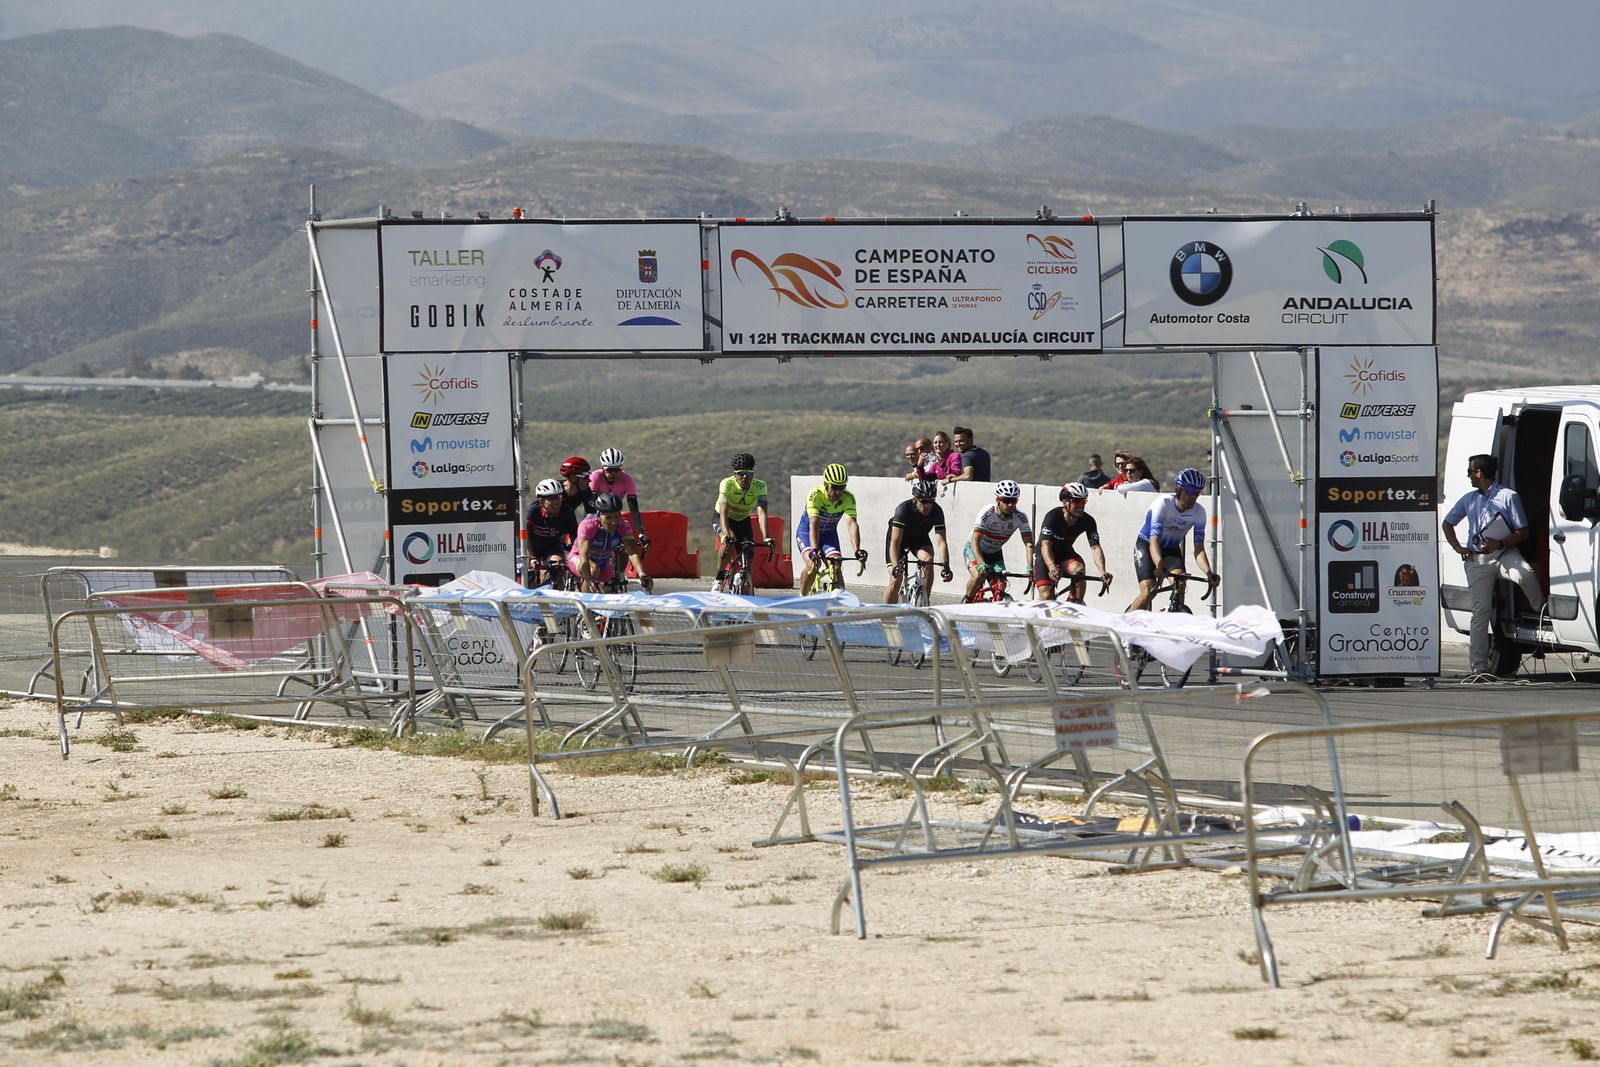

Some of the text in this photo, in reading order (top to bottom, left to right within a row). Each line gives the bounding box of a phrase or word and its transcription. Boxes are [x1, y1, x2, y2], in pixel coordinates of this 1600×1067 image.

[408, 249, 485, 266] TALLER
[855, 248, 996, 264] CAMPEONATO
[1175, 242, 1227, 262] BMW
[855, 265, 967, 283] DE ESPAÑA
[1027, 265, 1078, 274] CICLISMO
[409, 273, 486, 288] emarketing
[616, 287, 682, 299] DIPUTACIÓN
[509, 299, 582, 311] ALMERÍA
[617, 299, 681, 310] DE ALMERÍA
[855, 296, 949, 309] CARRETERA
[1027, 292, 1047, 311] CSD
[1282, 297, 1413, 310] ANDALUCIA
[410, 304, 486, 328] GOBIK
[502, 315, 594, 327] deslumbrante
[1150, 313, 1250, 324] Automotor Costa
[1281, 313, 1349, 325] CIRCUIT
[729, 329, 1095, 344] VI 12H TRACKMAN CYCLING ANDALUCÍA CIRCUIT
[1358, 370, 1406, 381] Cofidis
[429, 377, 479, 390] Cofidis
[1361, 404, 1416, 417] INVERSE
[432, 412, 489, 426] INVERSE
[1364, 429, 1417, 440] movistar
[436, 438, 491, 450] movistar
[1362, 521, 1410, 542] HLA Grupo
[1390, 532, 1430, 543] Hospitalario
[437, 532, 486, 554] HLA Grupo
[466, 543, 507, 554] Hospitalario
[1332, 591, 1376, 600] Construye
[1388, 588, 1427, 598] Cruzcampo
[1370, 624, 1429, 636] Centro
[1329, 633, 1430, 652] Granados
